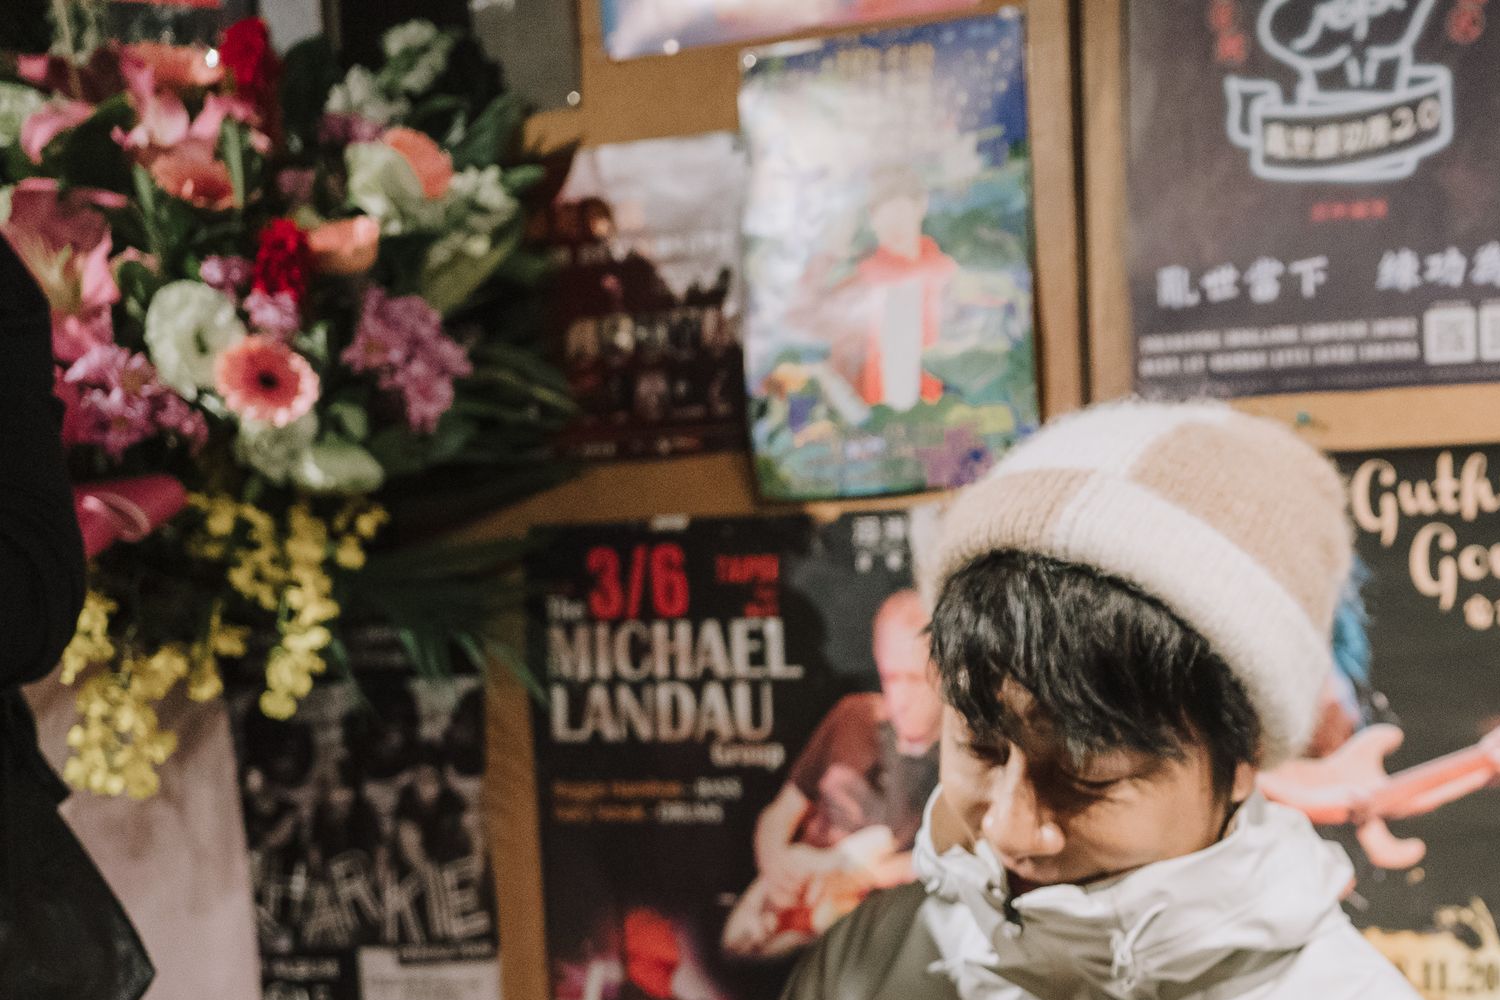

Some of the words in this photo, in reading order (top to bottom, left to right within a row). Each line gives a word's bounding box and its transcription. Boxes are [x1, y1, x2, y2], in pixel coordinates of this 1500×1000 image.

[586, 543, 690, 619] 3/6
[548, 617, 804, 682] MICHAEL
[550, 681, 775, 743] LANDAU
